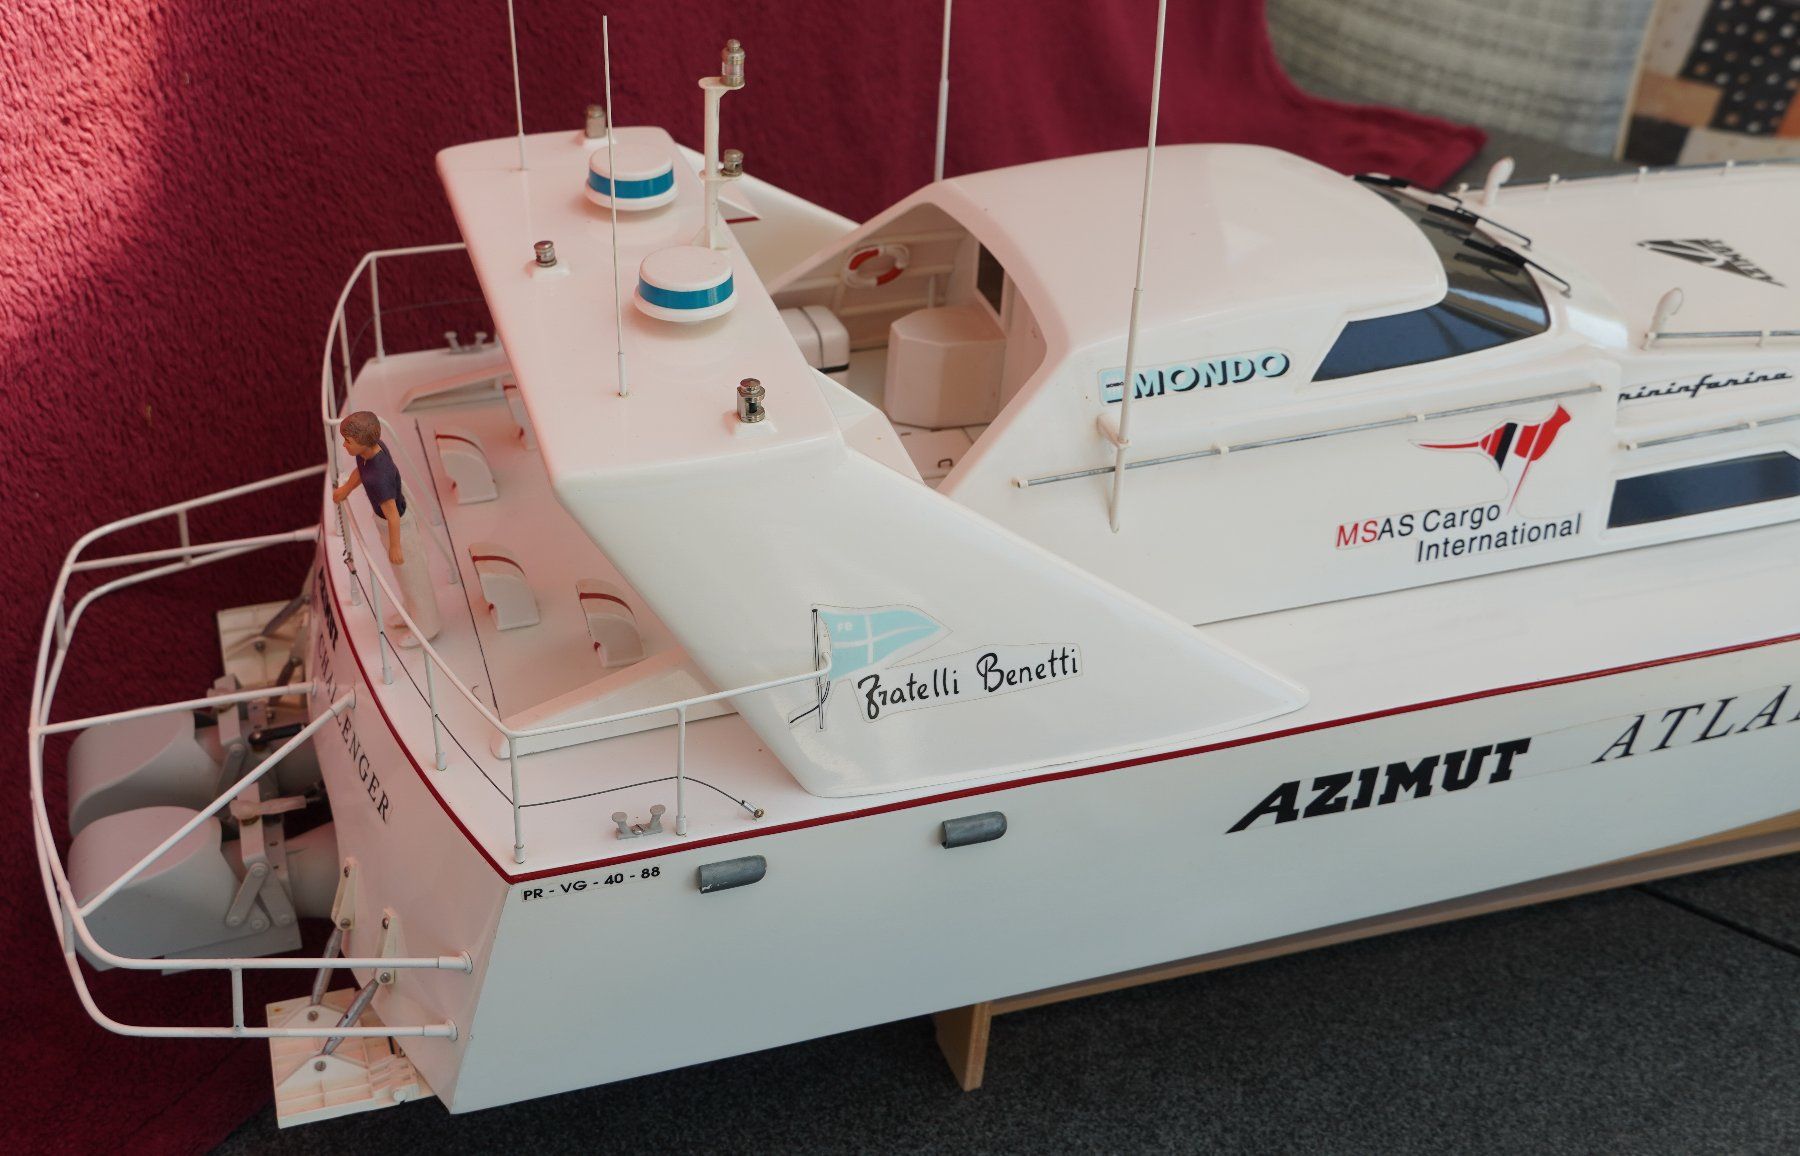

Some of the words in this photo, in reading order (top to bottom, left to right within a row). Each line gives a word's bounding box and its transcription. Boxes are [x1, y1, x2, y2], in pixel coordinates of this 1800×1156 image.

[1132, 350, 1290, 399] MONDO
[1335, 514, 1415, 548] MSAS
[1422, 503, 1501, 531] Cargo
[1417, 513, 1582, 563] International
[857, 666, 960, 720] Fratelli
[976, 646, 1079, 693] Benetti
[1224, 737, 1532, 835] AZIMUT
[1591, 685, 1800, 764] ATLA
[523, 888, 544, 901] PR
[560, 880, 587, 893] VG
[604, 873, 624, 885] 40
[641, 866, 661, 879] 88
